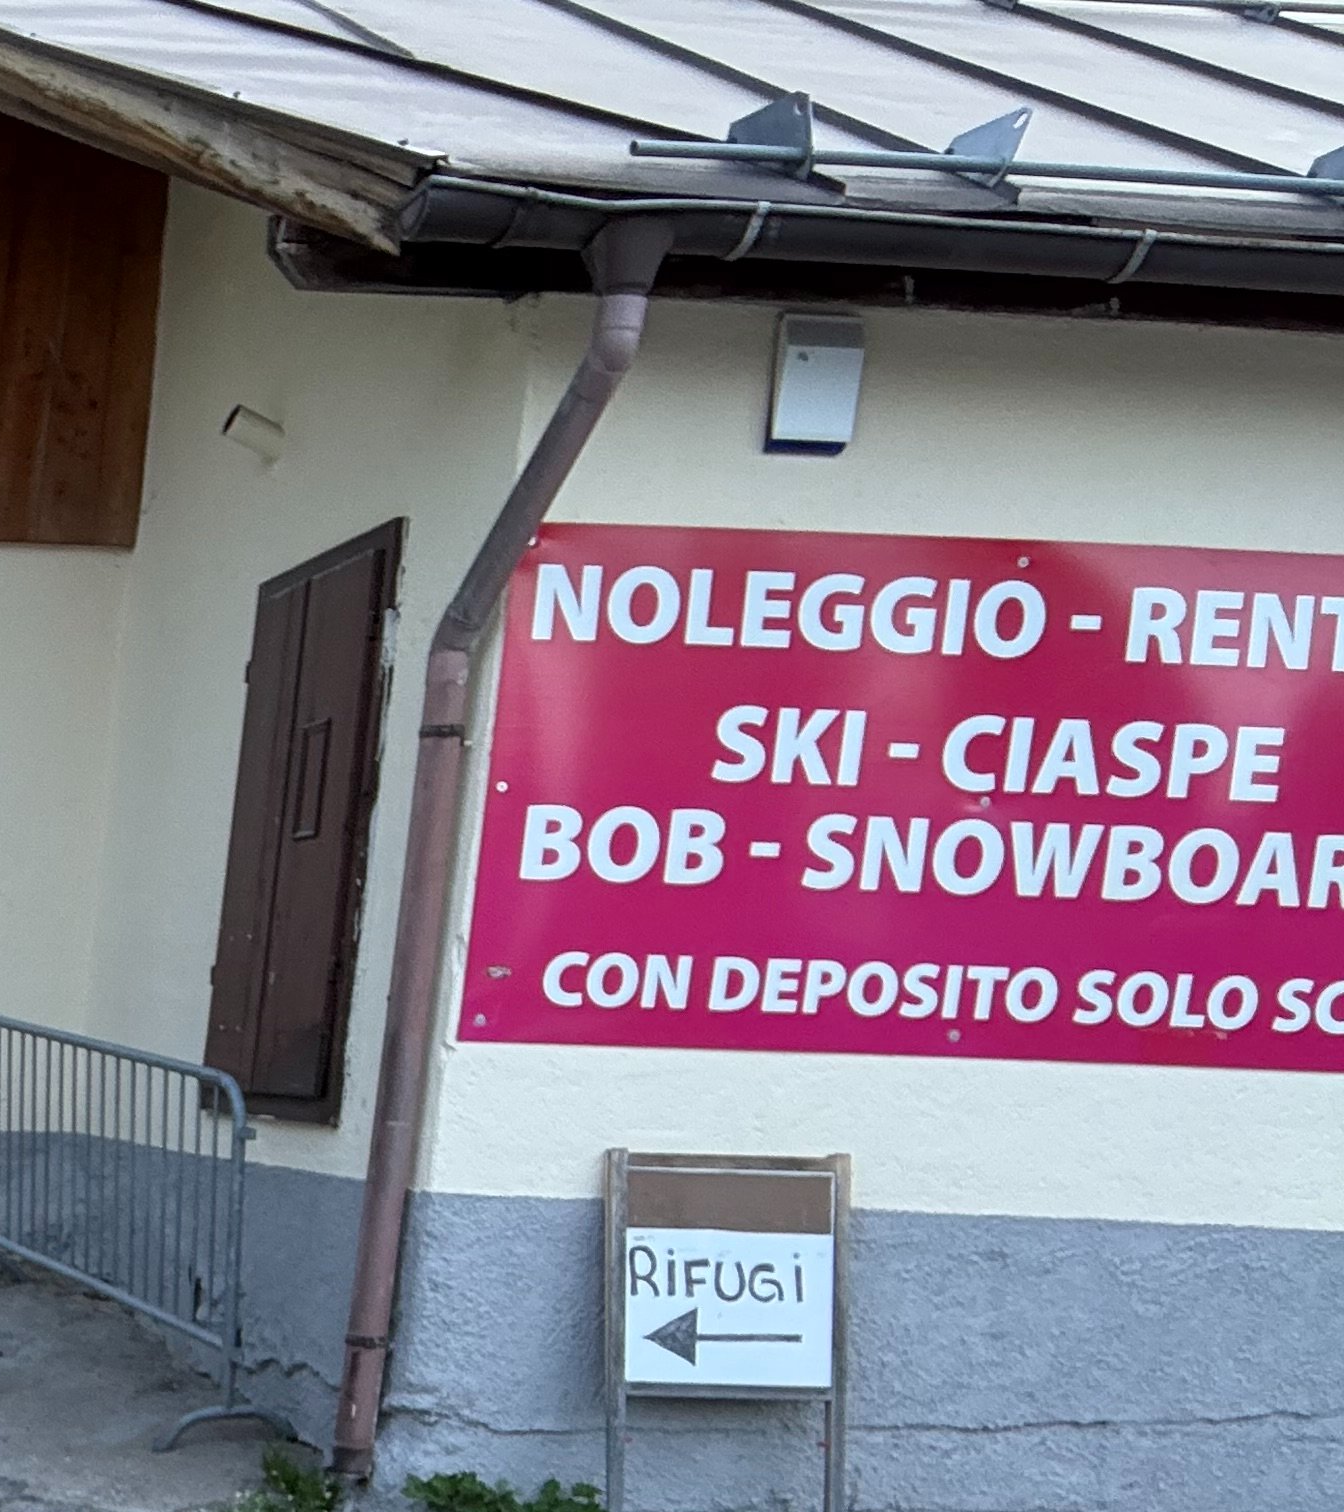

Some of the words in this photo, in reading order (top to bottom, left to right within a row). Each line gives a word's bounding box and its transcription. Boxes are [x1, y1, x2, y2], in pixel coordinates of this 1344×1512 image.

[530, 563, 1046, 659] NOLEGGIO
[1070, 614, 1102, 630] -
[711, 705, 867, 786] SKI
[888, 742, 920, 759] -
[942, 714, 1286, 803] CIASPE
[519, 804, 726, 885] BOB
[749, 841, 781, 858] -
[801, 813, 1344, 909] SNOWBOAR
[542, 951, 693, 1010] CON
[708, 956, 1058, 1022] DEPOSITO
[1072, 969, 1259, 1030] SOLO
